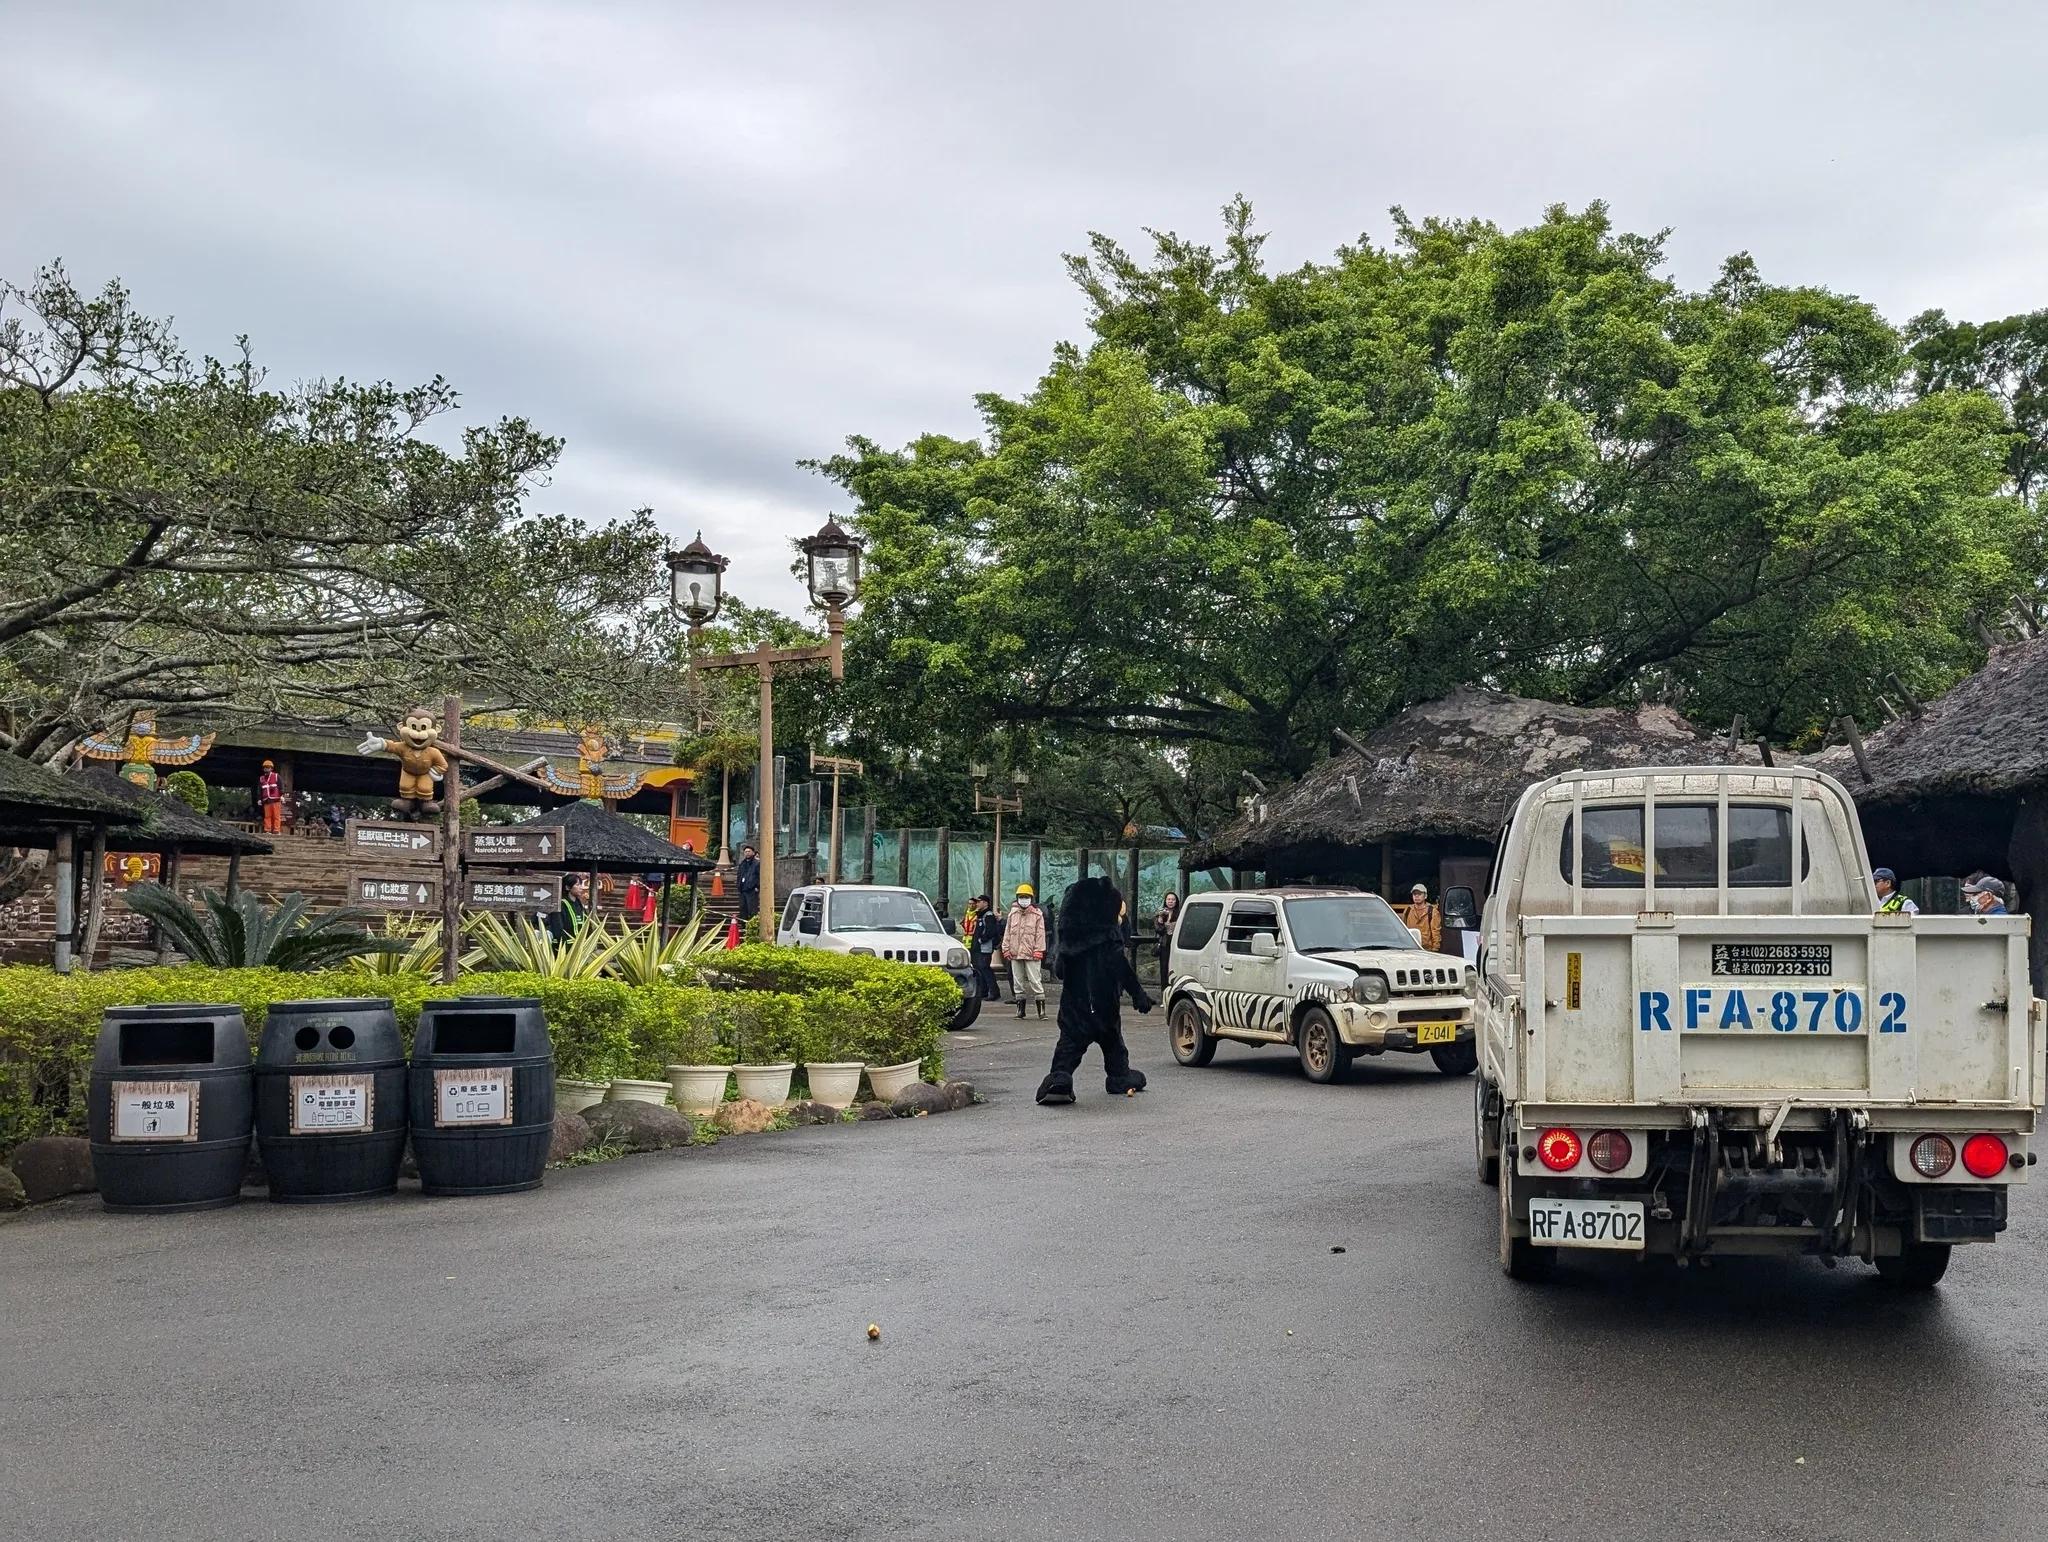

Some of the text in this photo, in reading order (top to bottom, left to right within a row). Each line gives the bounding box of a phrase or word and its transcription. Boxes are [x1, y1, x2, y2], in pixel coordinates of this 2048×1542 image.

[357, 830, 409, 843] 猛獸區巴士站
[474, 836, 517, 847] 蒸氣火車
[380, 883, 409, 895] 化妝室
[474, 884, 525, 896] 肯亞美食館
[131, 1101, 175, 1110] 一般垃圾
